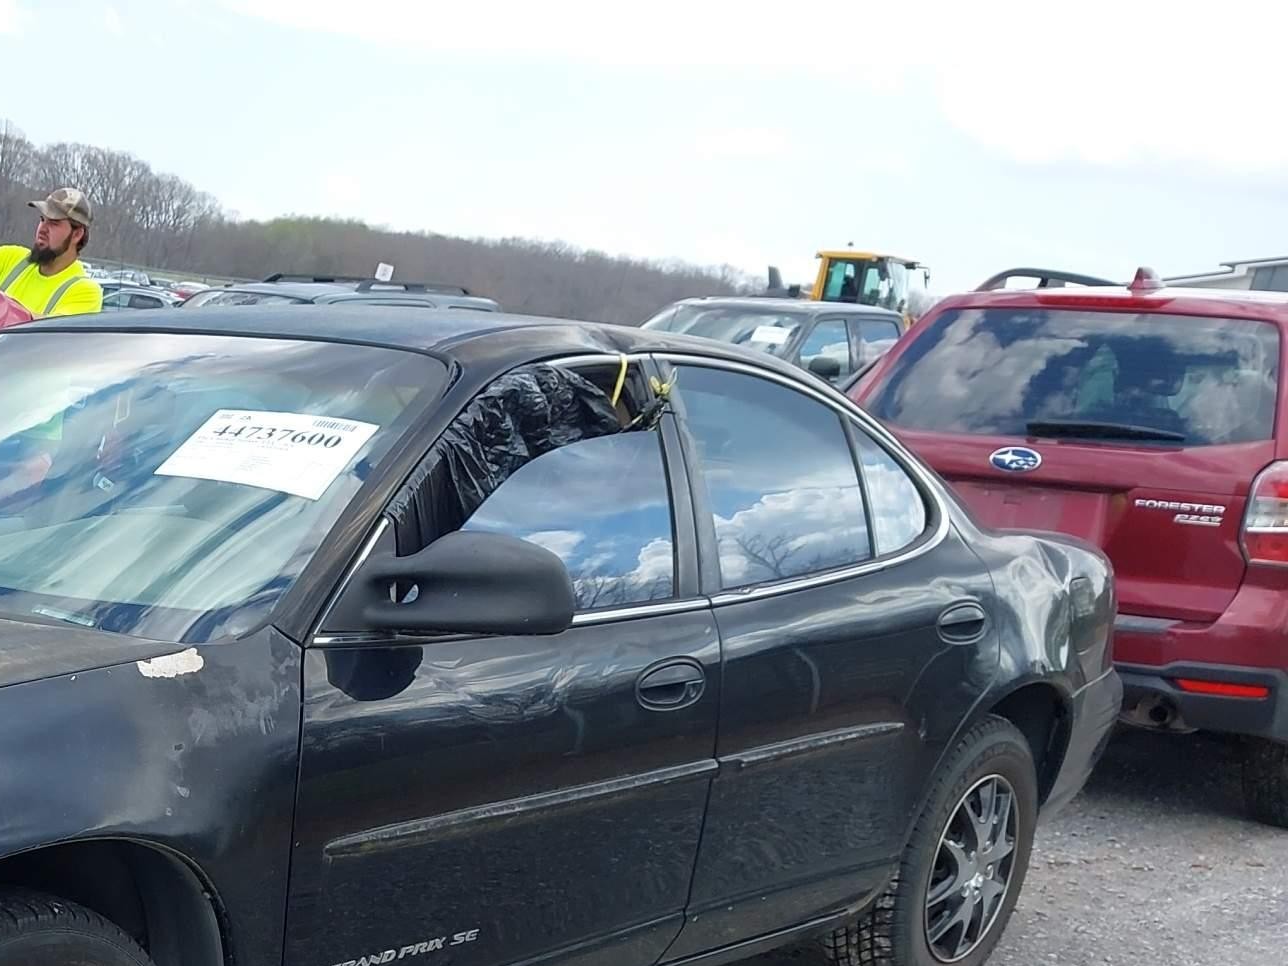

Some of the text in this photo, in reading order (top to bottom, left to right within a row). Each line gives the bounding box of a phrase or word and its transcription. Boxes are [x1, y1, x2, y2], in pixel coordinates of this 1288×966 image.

[214, 424, 342, 449] 44737600
[1134, 499, 1226, 514] FORESTER
[398, 937, 447, 959] PRIX
[450, 929, 480, 946] SE
